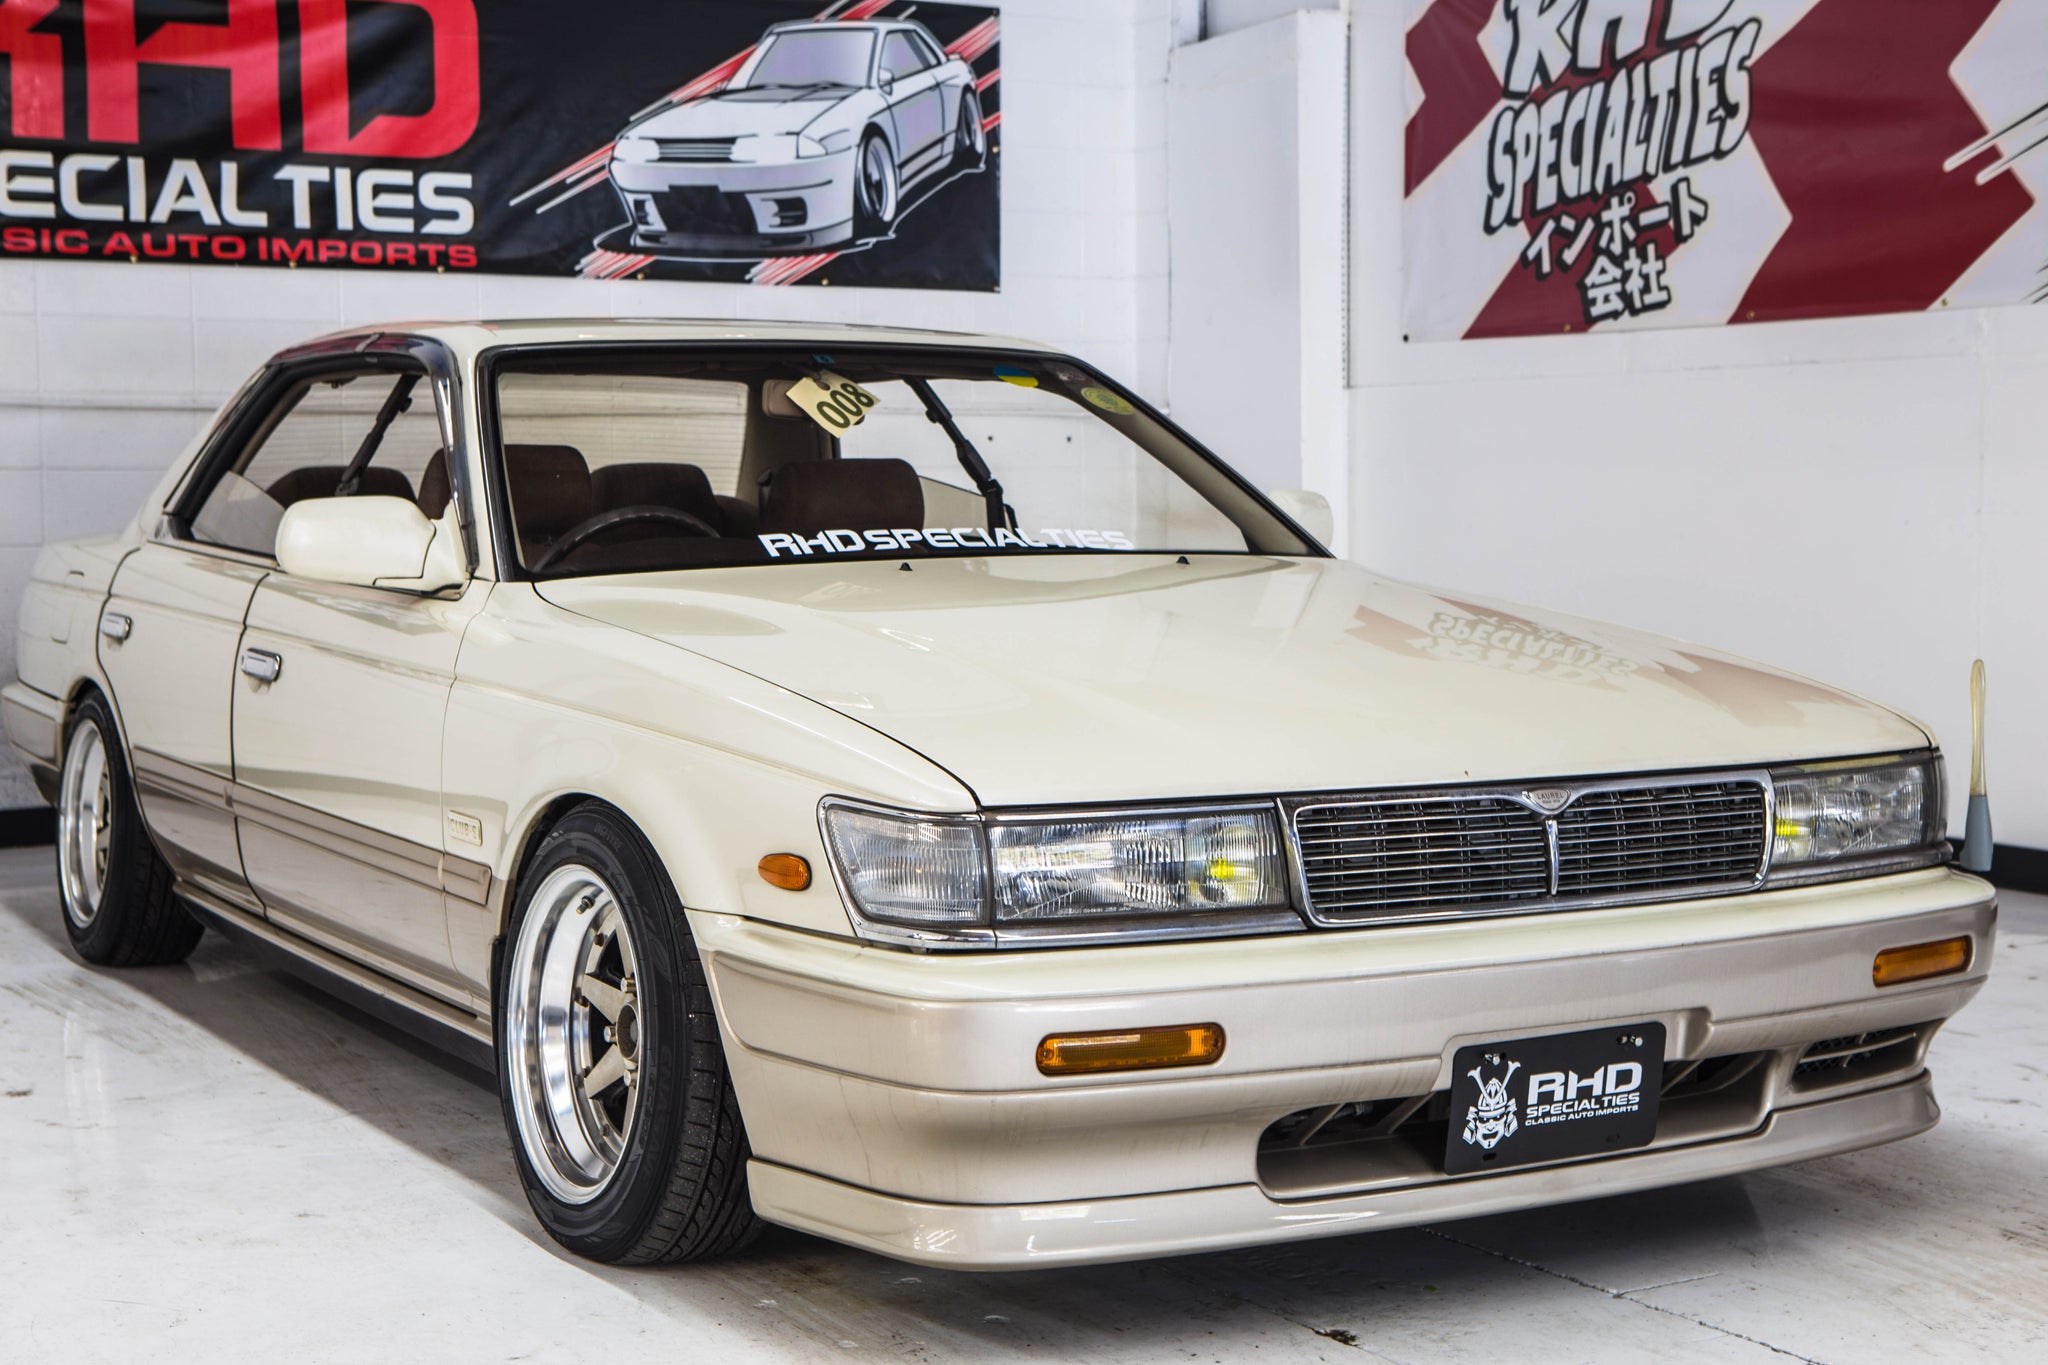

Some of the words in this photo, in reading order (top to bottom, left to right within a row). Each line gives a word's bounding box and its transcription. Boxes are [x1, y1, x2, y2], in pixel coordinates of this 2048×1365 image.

[1484, 18, 1762, 234] SPECIALTIES
[0, 150, 475, 235] ECIALTIES
[102, 231, 246, 260] AUTO
[259, 237, 477, 267] IMPORTS
[1520, 177, 1708, 280] インポート
[1577, 242, 1672, 324] 会社
[816, 383, 875, 428] 008
[1525, 1091, 1640, 1119] SPECIALTIES
[1527, 1061, 1643, 1105] RHD
[1525, 1113, 1567, 1126] CLASSIC
[1567, 1109, 1594, 1120] AUTO
[1595, 1103, 1639, 1116] IMPORTS
